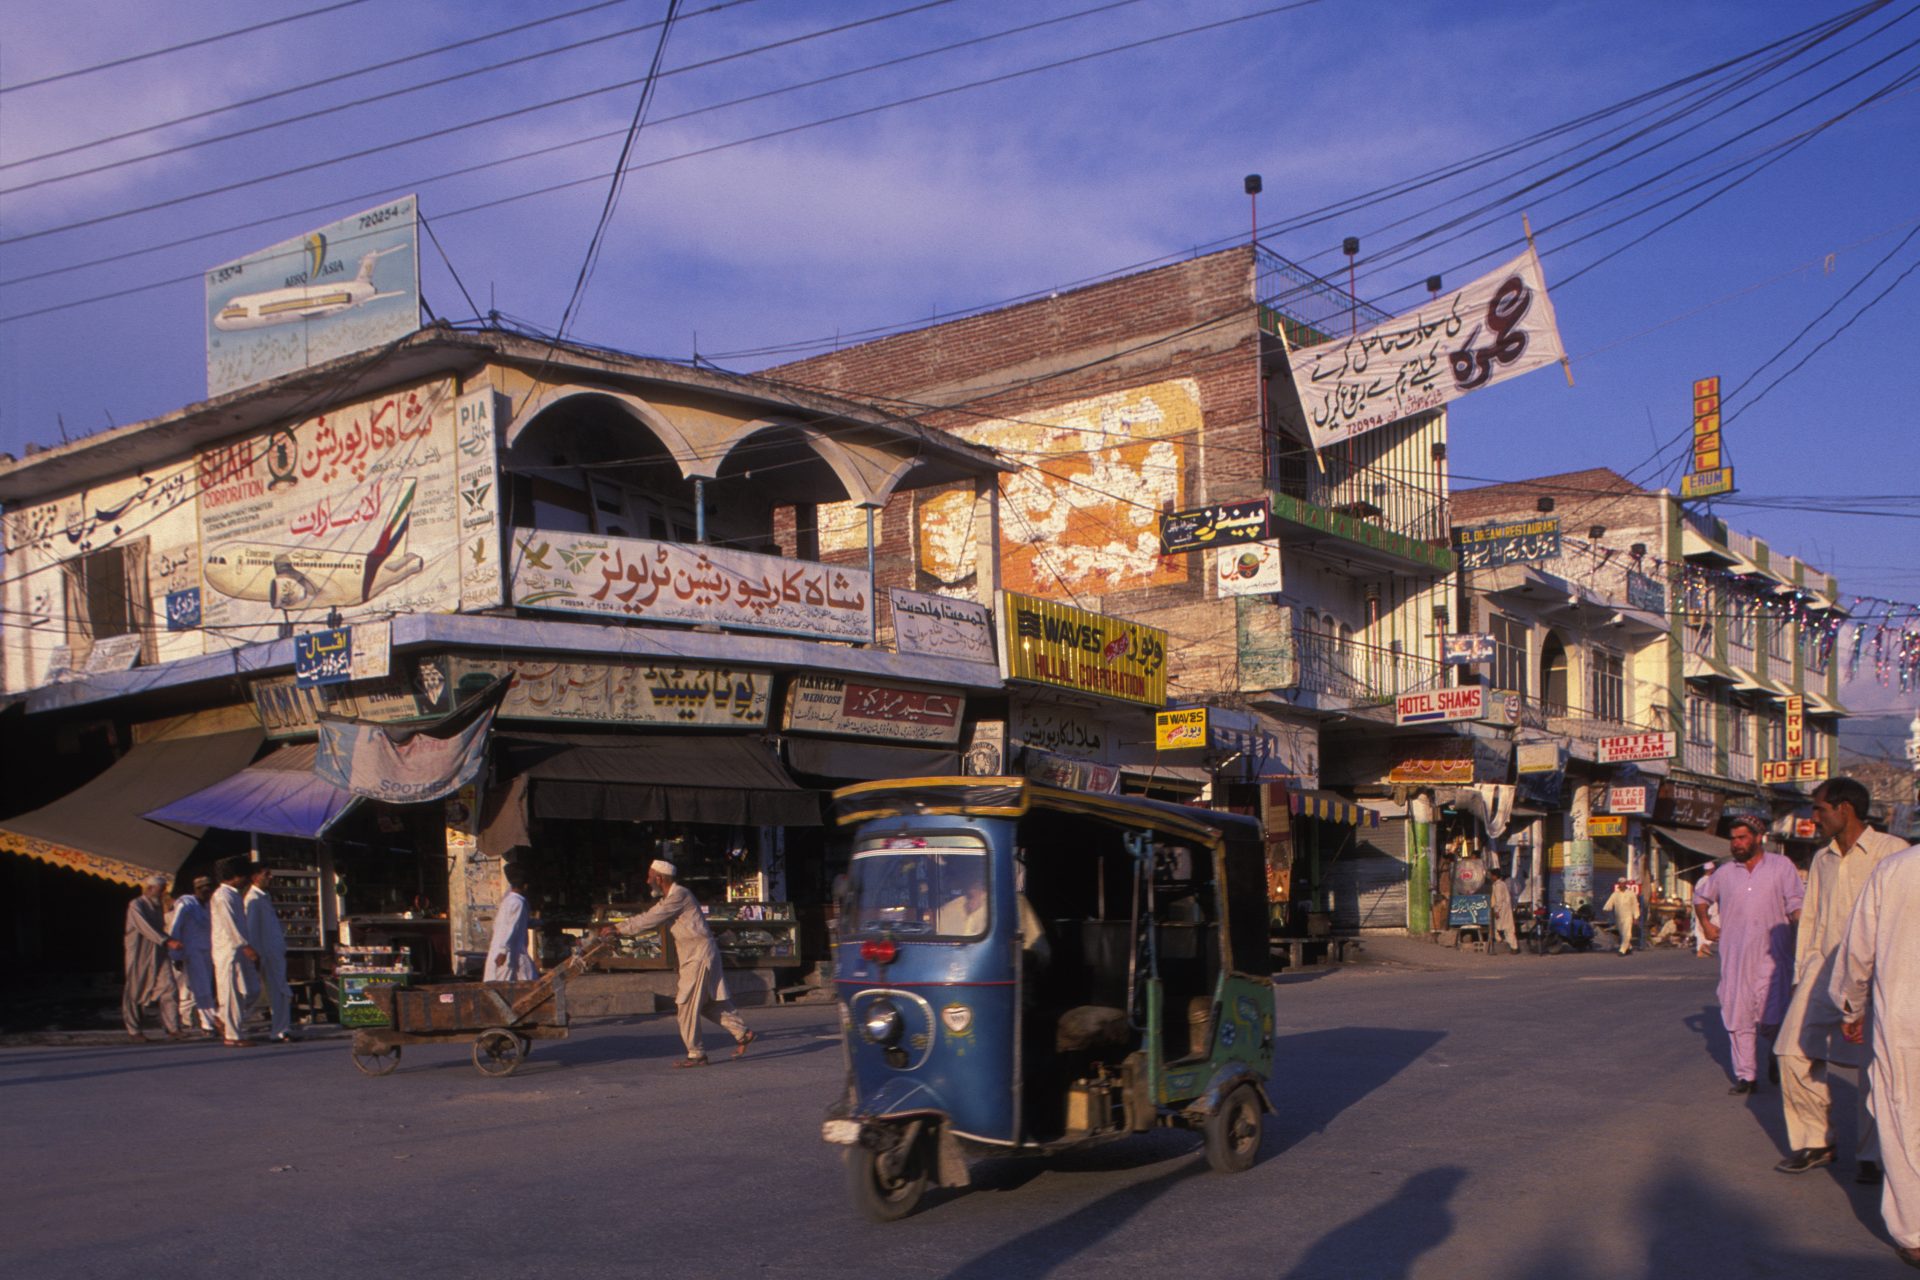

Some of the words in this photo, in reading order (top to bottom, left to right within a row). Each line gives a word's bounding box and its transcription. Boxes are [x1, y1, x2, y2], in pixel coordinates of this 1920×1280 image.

[385, 392, 433, 448] شاہ
[461, 400, 487, 426] PIA
[1346, 416, 1384, 436] 720994
[1695, 379, 1718, 470] HOTEL
[301, 400, 394, 483] کارپوریشن
[200, 440, 254, 490] SHAH
[203, 479, 264, 509] CORPORATION
[553, 577, 574, 590] PIA
[590, 543, 672, 615] ٹریولز
[804, 568, 865, 612] شاہ
[305, 631, 347, 660] اقبال
[1042, 614, 1105, 654] WAVES
[1126, 625, 1164, 678] ویوز
[799, 674, 846, 692] HAKEEM
[1033, 652, 1074, 683] HILLAL
[1078, 663, 1146, 698] CORPORATION
[801, 691, 843, 706] MEDICOSE
[1398, 694, 1435, 715] HOTEL
[1438, 688, 1481, 711] SHAMS
[1169, 711, 1204, 725] WAVES
[1787, 697, 1801, 758] ERUM
[1601, 733, 1673, 749] HOTEL
[1608, 743, 1665, 755] DREAM
[1763, 761, 1827, 780] HOTEL
